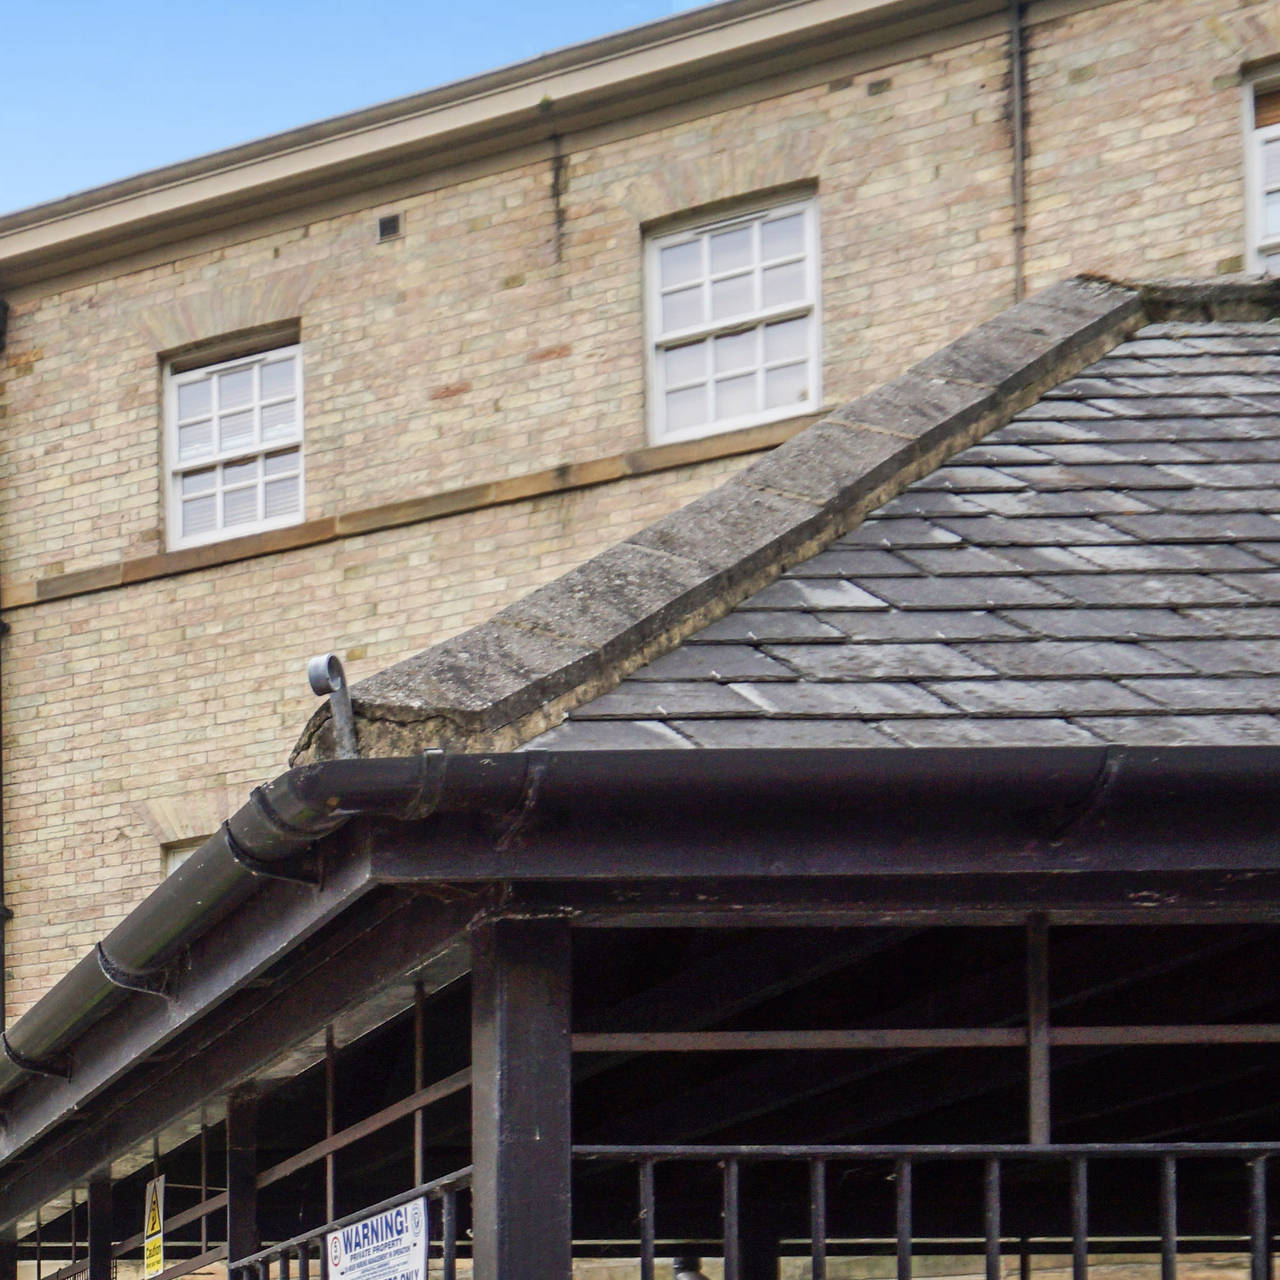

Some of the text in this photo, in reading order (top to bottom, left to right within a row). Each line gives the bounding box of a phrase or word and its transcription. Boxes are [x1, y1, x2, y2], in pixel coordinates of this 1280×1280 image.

[343, 1207, 408, 1254] WARNING!
[350, 1248, 371, 1262] PRIVATE
[372, 1238, 403, 1254] PROPERTY
